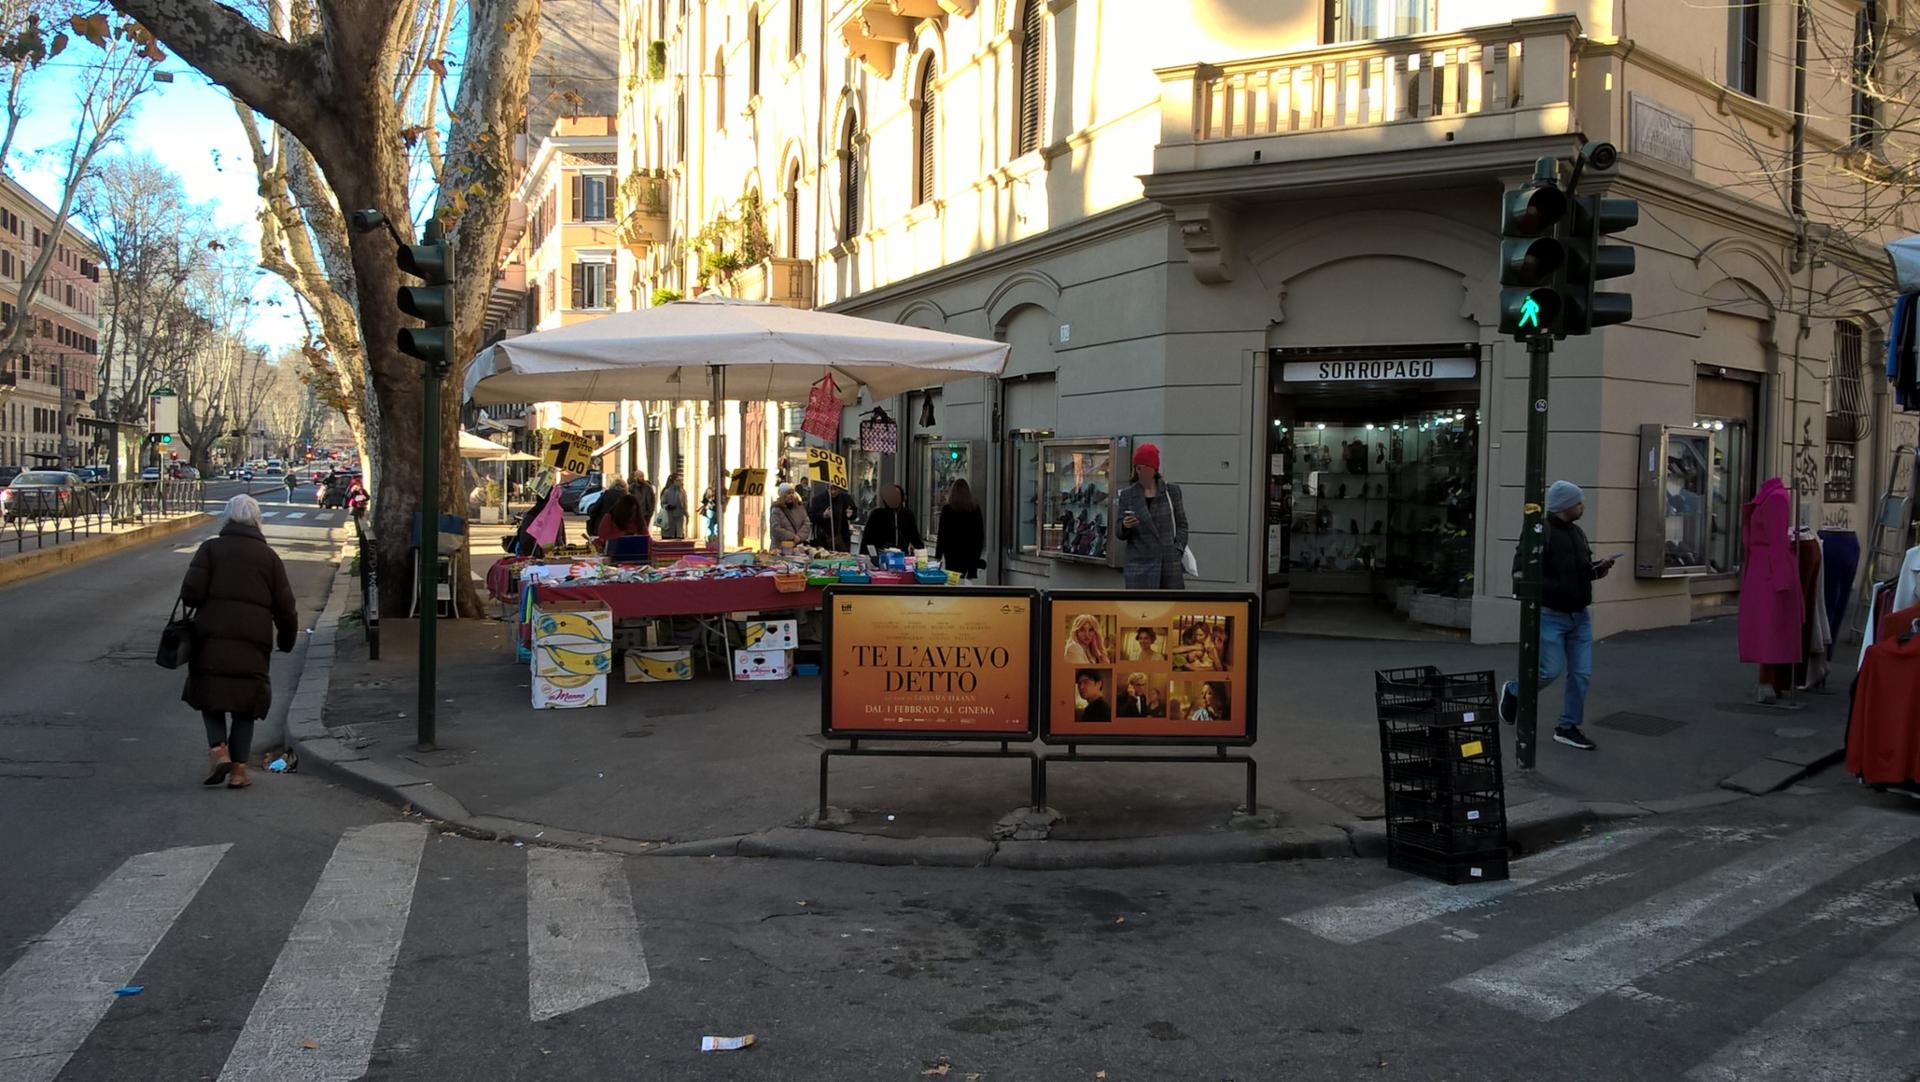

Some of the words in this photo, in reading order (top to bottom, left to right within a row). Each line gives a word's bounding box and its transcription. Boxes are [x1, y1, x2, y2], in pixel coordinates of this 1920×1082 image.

[1319, 360, 1433, 379] SORROPAGO
[573, 441, 593, 452] TUTTO
[810, 448, 843, 466] SOLO
[852, 645, 888, 668] TE
[895, 645, 1009, 669] L'AVEVO
[885, 670, 977, 693] DETTO
[865, 704, 883, 713] DAL
[894, 705, 939, 714] FEBBRAIO
[943, 706, 954, 714] AL
[958, 706, 995, 715] CINEMA
